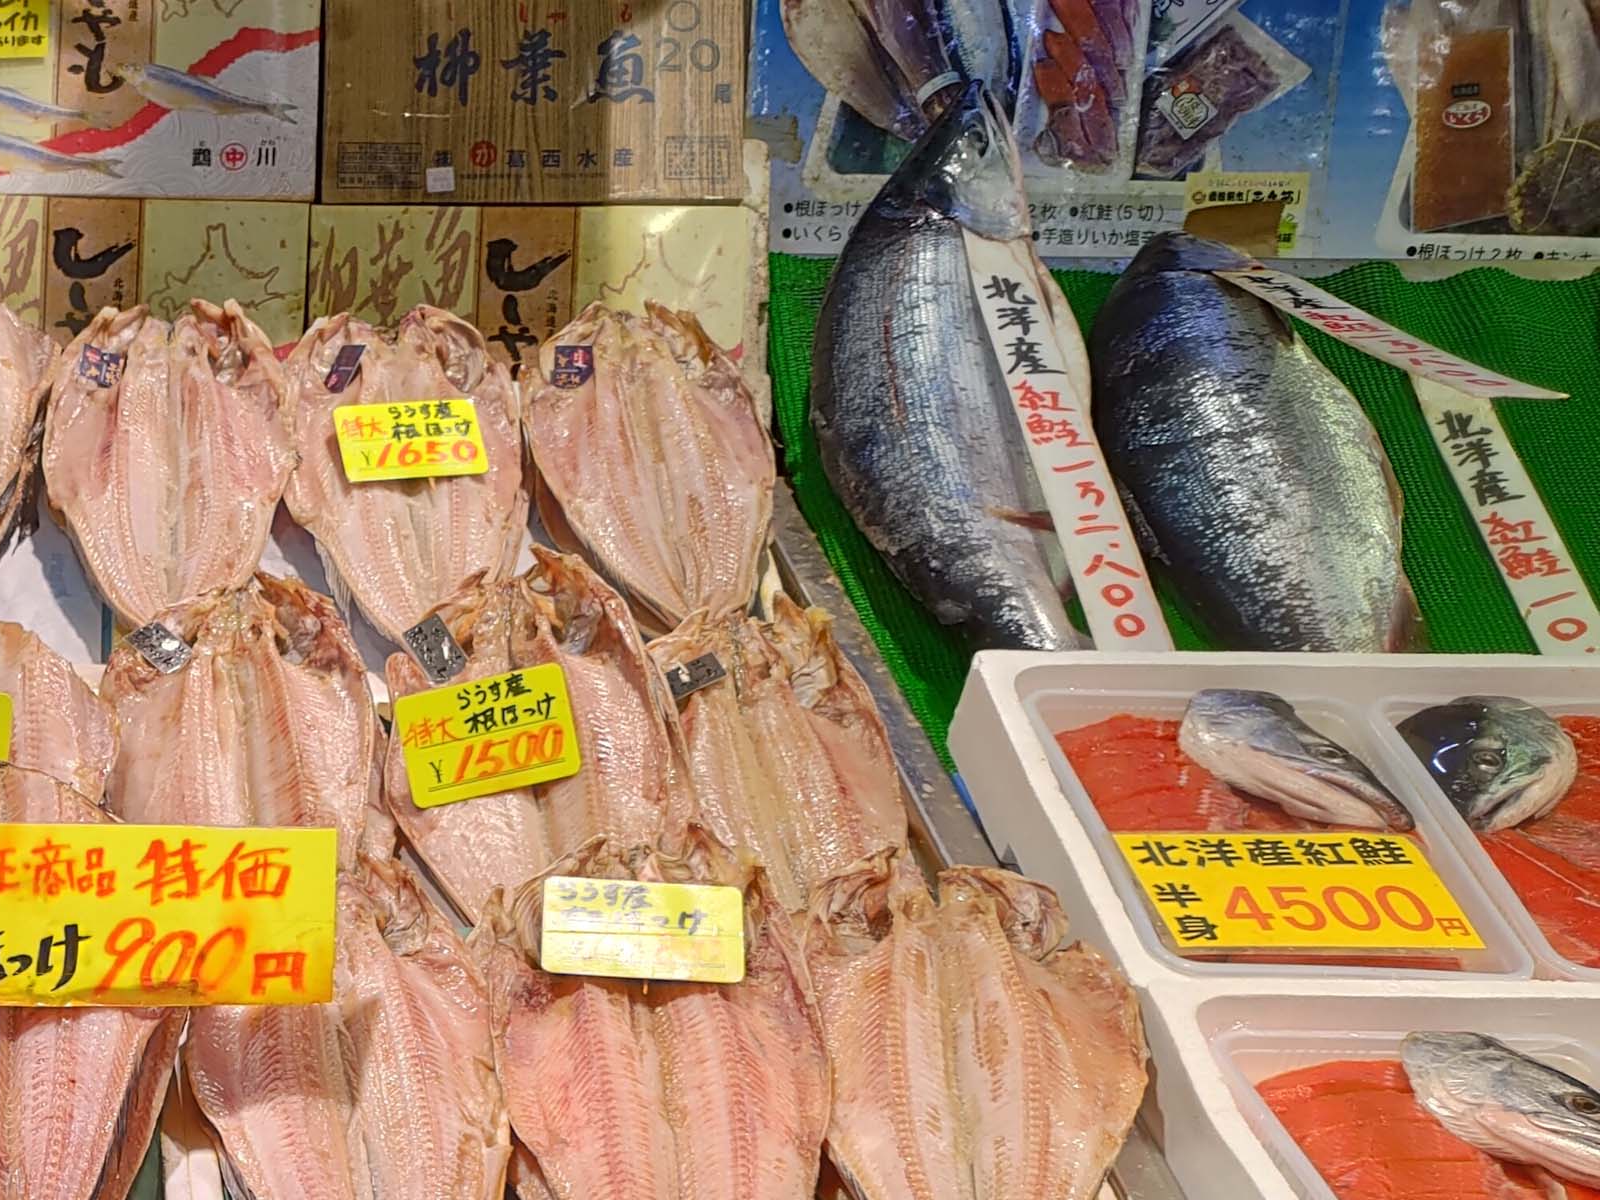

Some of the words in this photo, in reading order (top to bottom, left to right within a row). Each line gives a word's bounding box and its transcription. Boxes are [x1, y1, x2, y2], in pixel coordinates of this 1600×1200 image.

[361, 440, 479, 468] ¥1650
[457, 672, 533, 711] らうす産
[464, 692, 557, 736] 根ほっけ
[429, 722, 565, 785] ¥1500
[134, 838, 293, 902] 特価
[1131, 837, 1414, 867] 北洋産紅鮭
[1154, 882, 1219, 943] 半身
[1223, 884, 1471, 939] 4500円
